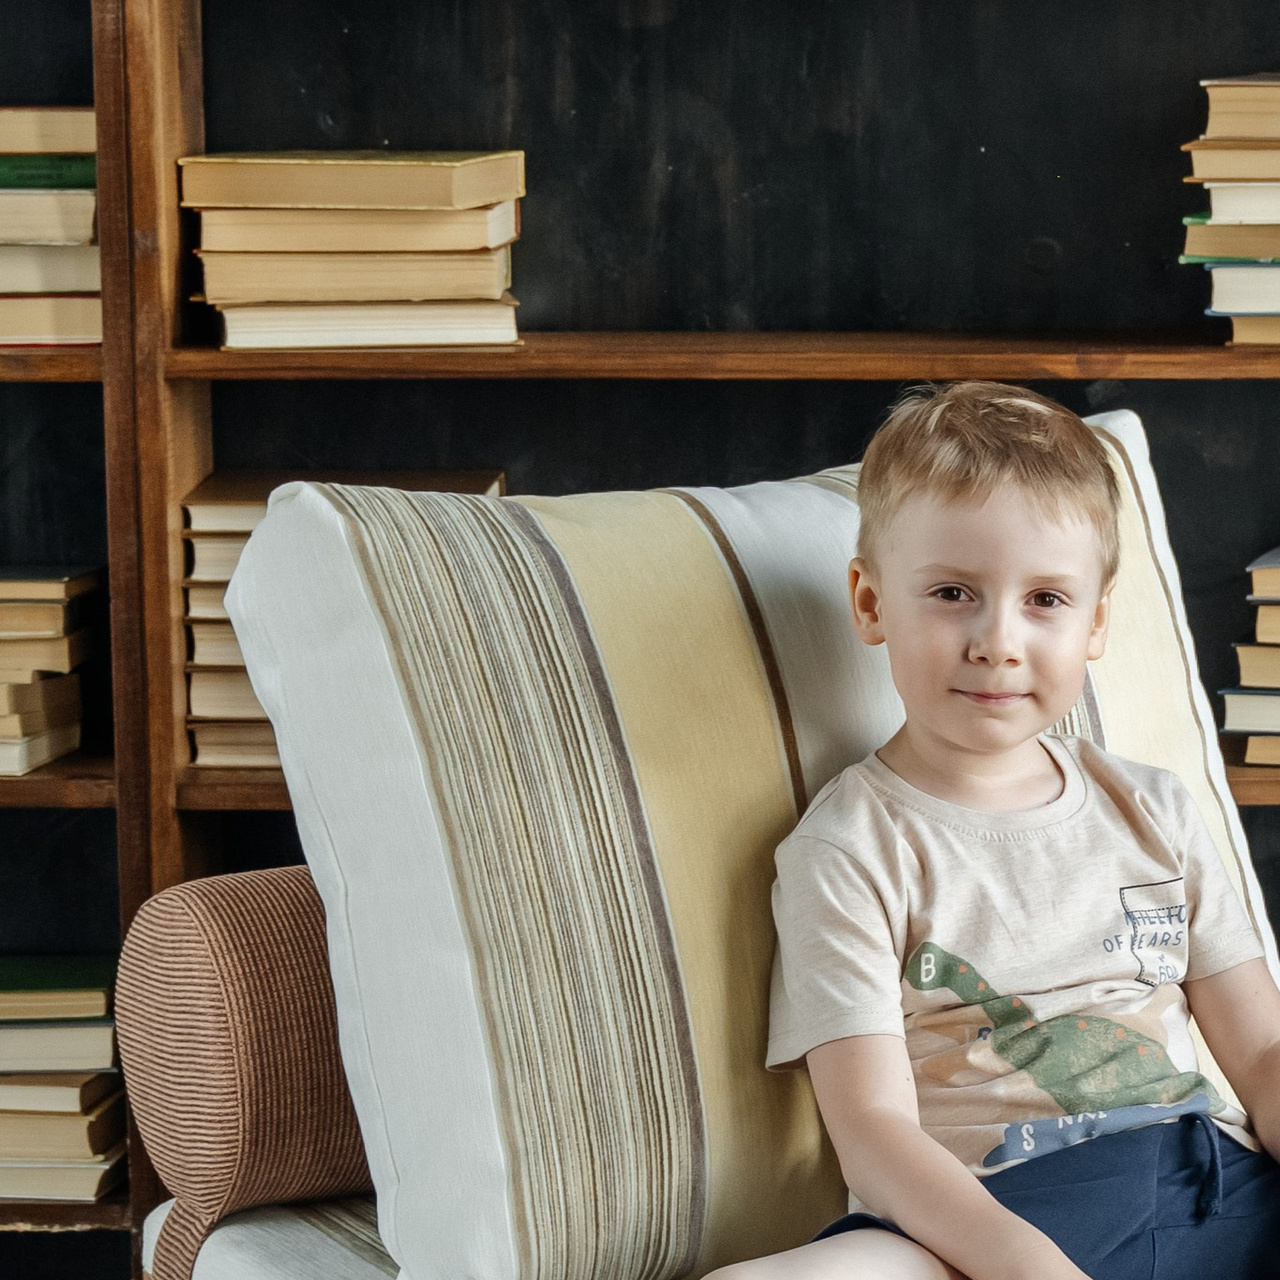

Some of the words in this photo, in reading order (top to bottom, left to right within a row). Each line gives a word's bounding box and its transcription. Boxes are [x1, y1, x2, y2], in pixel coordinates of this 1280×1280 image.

[1102, 934, 1123, 953] OF
[920, 952, 936, 983] B
[1020, 1124, 1035, 1151] S
